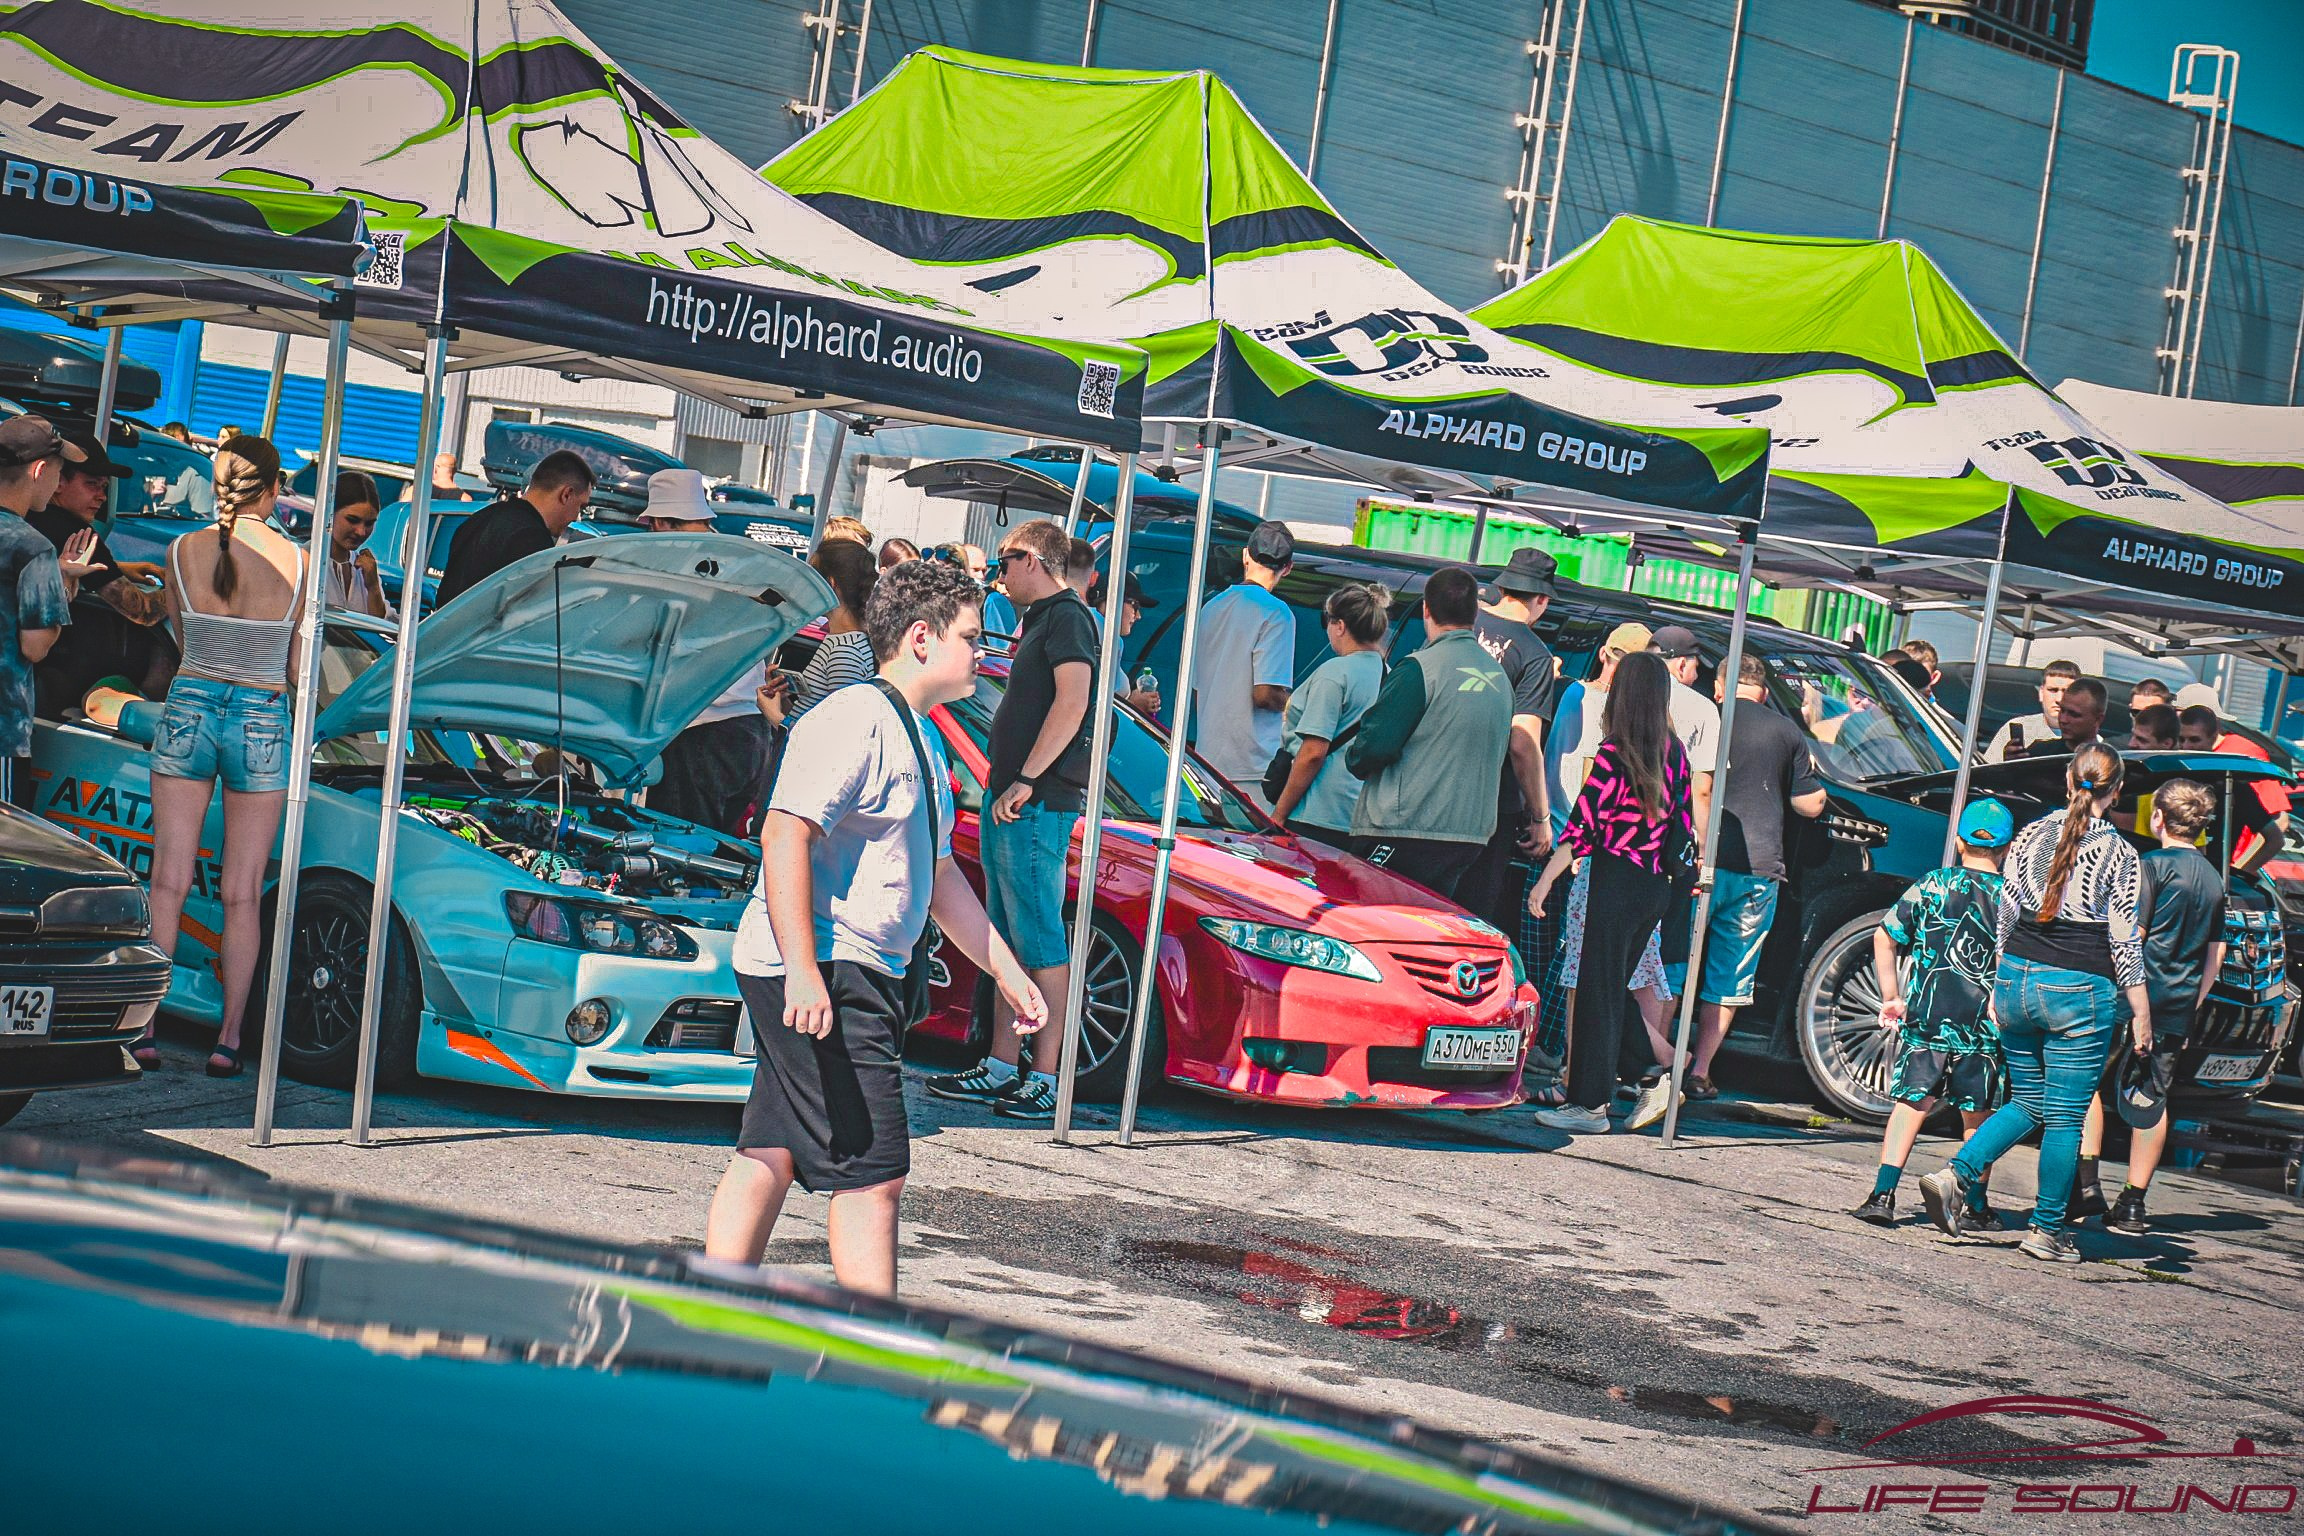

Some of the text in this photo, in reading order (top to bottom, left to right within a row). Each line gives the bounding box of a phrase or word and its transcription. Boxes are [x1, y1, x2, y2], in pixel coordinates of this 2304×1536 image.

[645, 277, 983, 382] http://alphard.audio
[1378, 409, 1648, 476] ALPHARD GROUP
[2103, 537, 2285, 590] ALPHARD GROUP
[2, 990, 45, 1018] 142
[13, 1020, 35, 1031] RUS
[1494, 1035, 1515, 1053] 550
